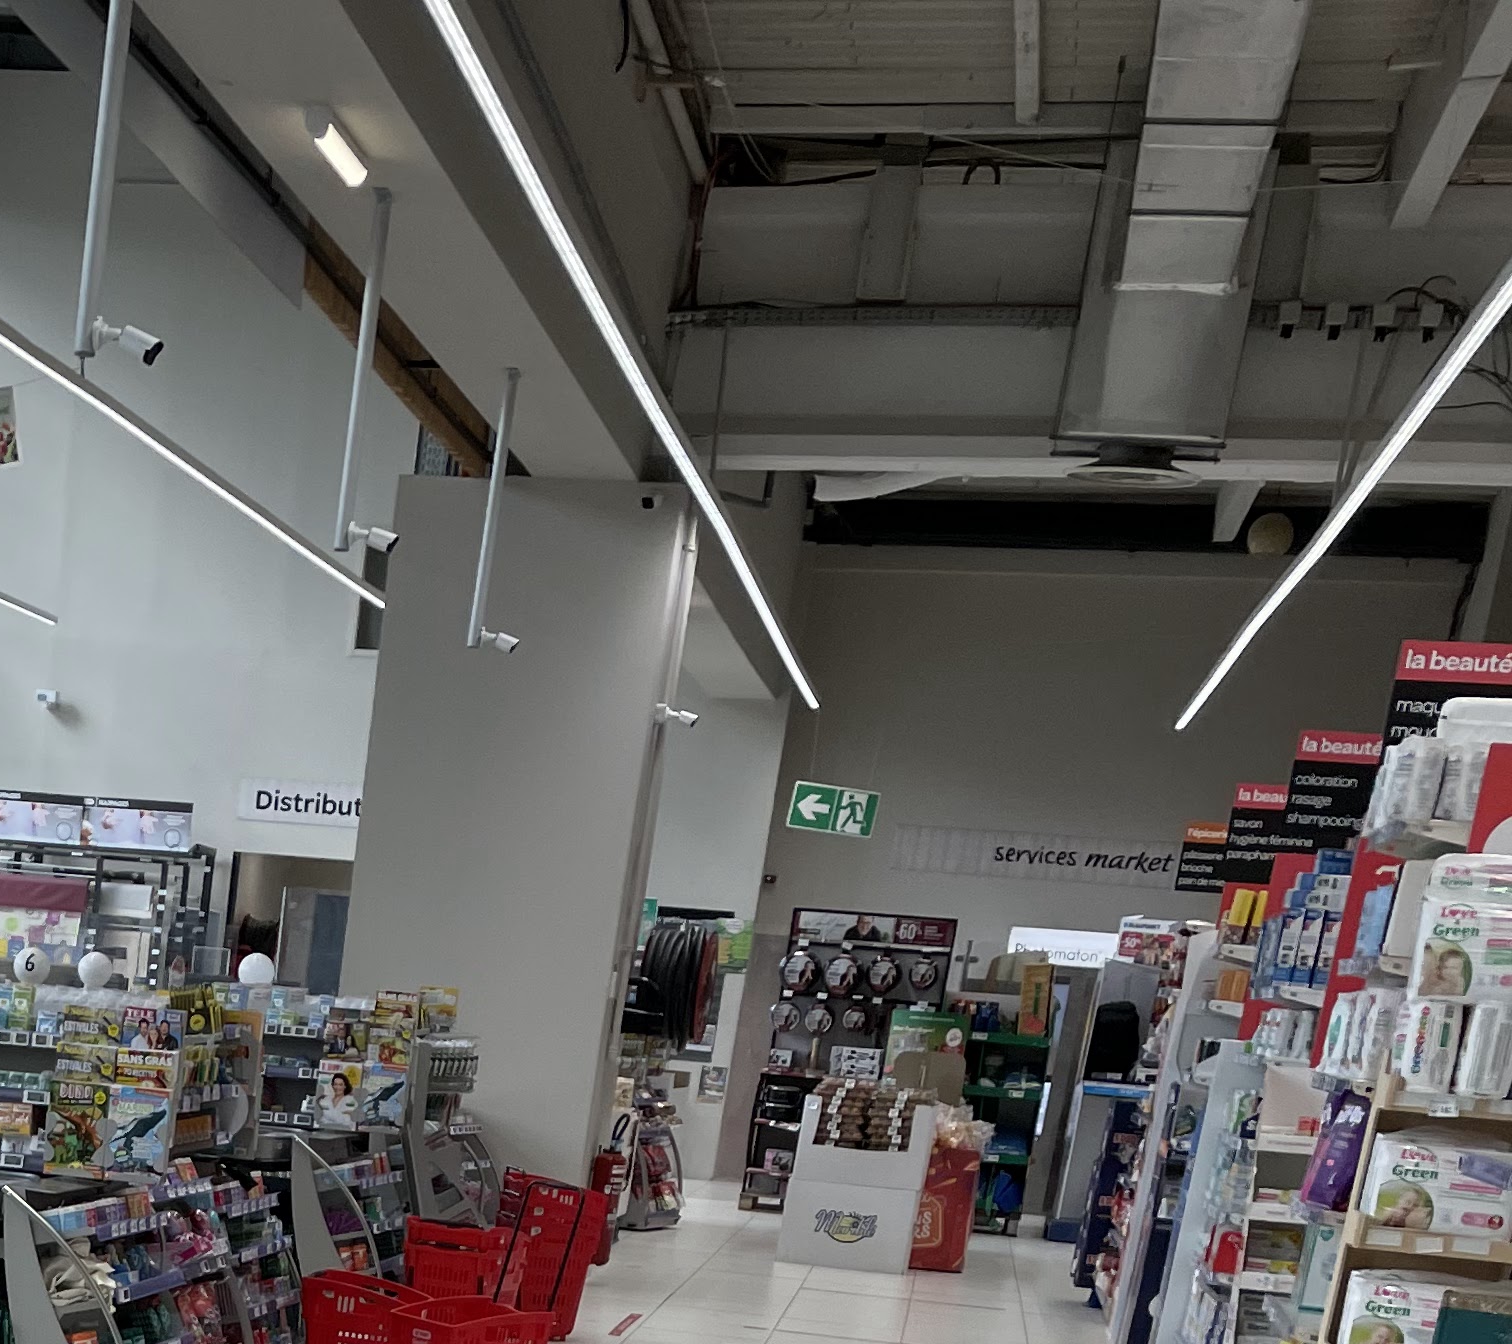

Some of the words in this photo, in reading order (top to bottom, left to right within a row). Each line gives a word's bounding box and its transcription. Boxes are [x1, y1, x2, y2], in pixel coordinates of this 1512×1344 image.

[1405, 648, 1426, 669] la
[1429, 650, 1512, 673] beauté
[1301, 736, 1319, 752] la
[1320, 737, 1383, 756] beauté
[1238, 787, 1251, 802] la
[1291, 794, 1333, 809] rasage
[994, 846, 1078, 867] services
[1085, 851, 1175, 873] market
[1433, 925, 1480, 937] Green
[25, 953, 35, 971] 6
[1392, 1164, 1439, 1180] Green
[1365, 1300, 1411, 1317] Green
